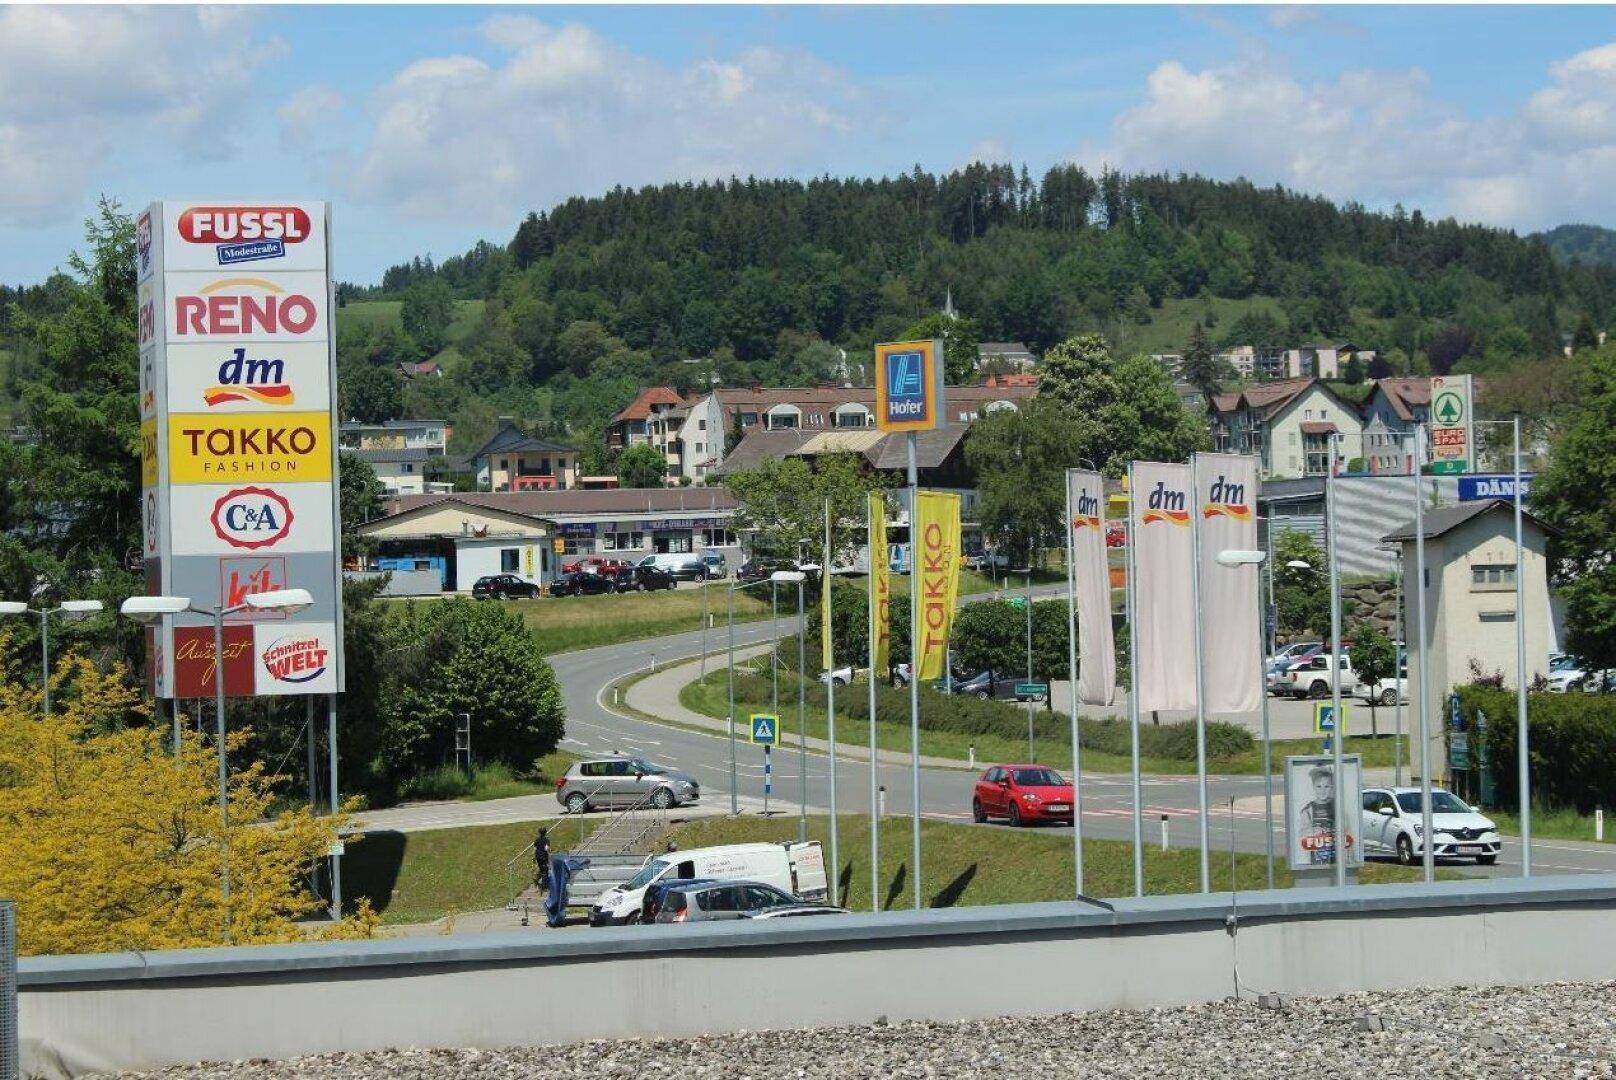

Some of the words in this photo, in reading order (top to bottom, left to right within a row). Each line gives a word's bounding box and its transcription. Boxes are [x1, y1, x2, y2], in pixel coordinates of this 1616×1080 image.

[192, 212, 301, 239] FUSSL
[175, 294, 318, 335] RENO
[218, 348, 285, 385] dm
[888, 399, 923, 416] Hofer
[204, 461, 297, 473] FASHION
[1078, 488, 1098, 517] dm
[1148, 481, 1186, 511] dm
[1209, 476, 1244, 504] dm
[225, 504, 279, 531] C&A
[267, 649, 328, 680] WELT
